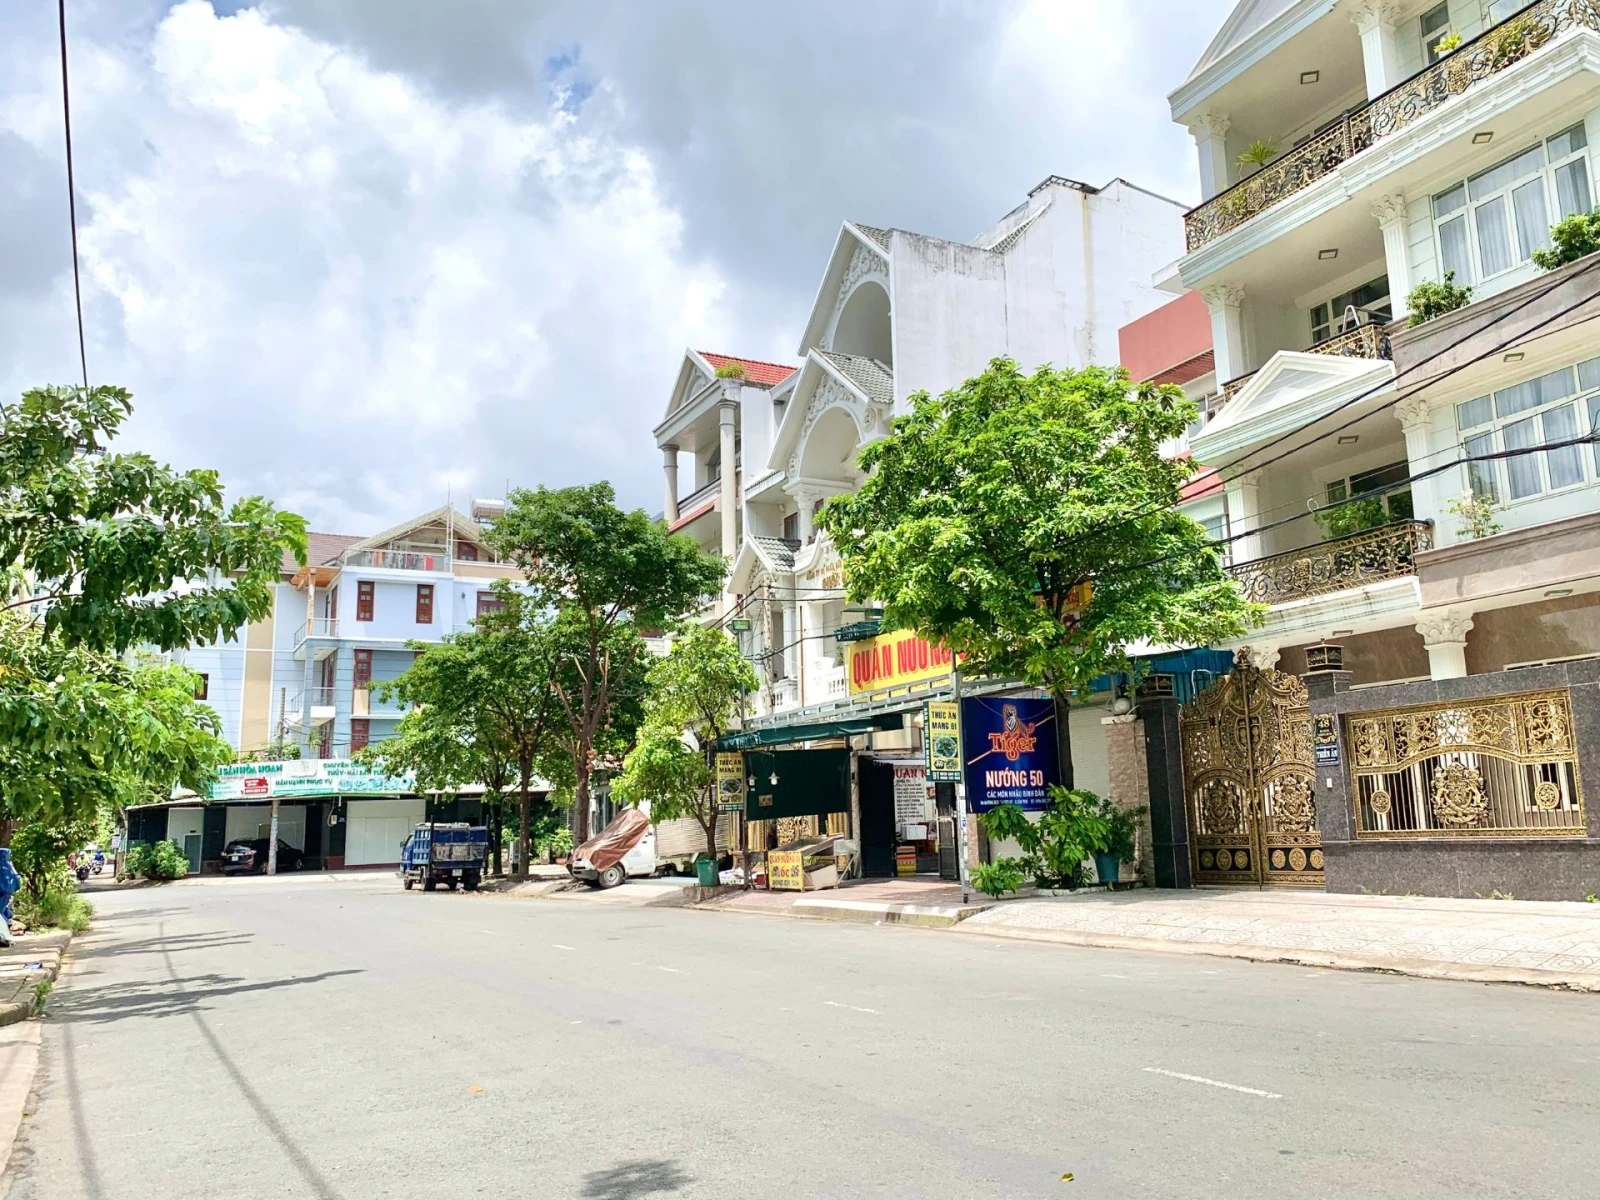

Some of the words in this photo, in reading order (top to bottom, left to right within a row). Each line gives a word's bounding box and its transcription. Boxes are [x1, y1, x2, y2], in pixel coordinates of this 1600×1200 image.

[853, 640, 893, 690] QUÁN
[932, 722, 949, 730] MANG
[1318, 719, 1330, 728] 48
[988, 731, 1037, 760] Tiger
[985, 767, 1028, 788] NƯỚNG
[1030, 770, 1044, 787] 50
[986, 790, 997, 799] CÁC
[998, 790, 1008, 798] MÓN
[1023, 789, 1034, 798] BÌNH
